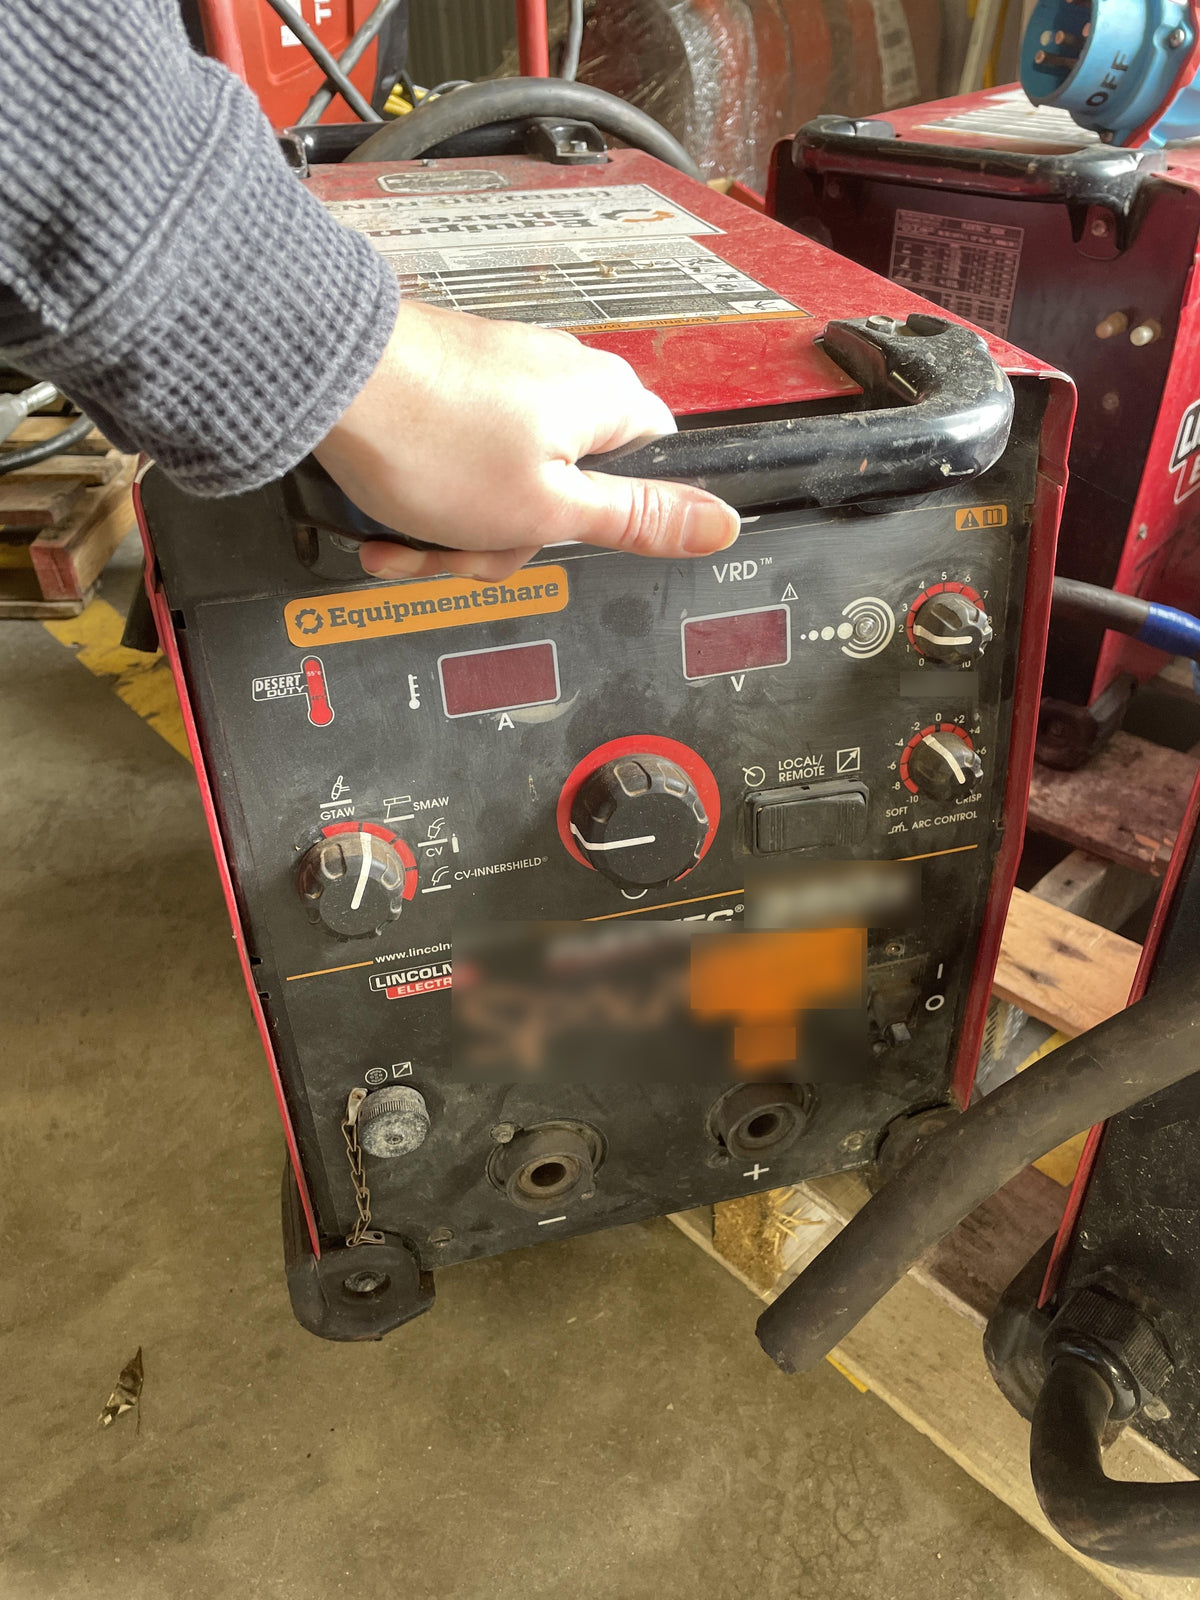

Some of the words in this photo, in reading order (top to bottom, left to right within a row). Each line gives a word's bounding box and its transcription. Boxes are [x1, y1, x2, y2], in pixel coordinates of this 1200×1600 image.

[1086, 51, 1129, 107] OFF
[419, 209, 586, 224] Share
[941, 572, 947, 581] 5
[965, 574, 971, 582] 6
[919, 581, 925, 589] 4
[328, 581, 559, 628] EquipmentShare
[898, 625, 905, 633] 2
[255, 674, 301, 692] DESERT
[730, 675, 746, 693] V
[266, 684, 309, 698] DUTY
[497, 713, 515, 730] A
[778, 754, 823, 772] LOCAL/
[778, 766, 825, 783] REMOTE
[412, 797, 450, 811] SMAW
[319, 807, 356, 821] GTAW
[885, 806, 908, 817] SOFT
[911, 819, 932, 830] ARC
[933, 810, 978, 825] CONTROL
[425, 846, 444, 858] CV
